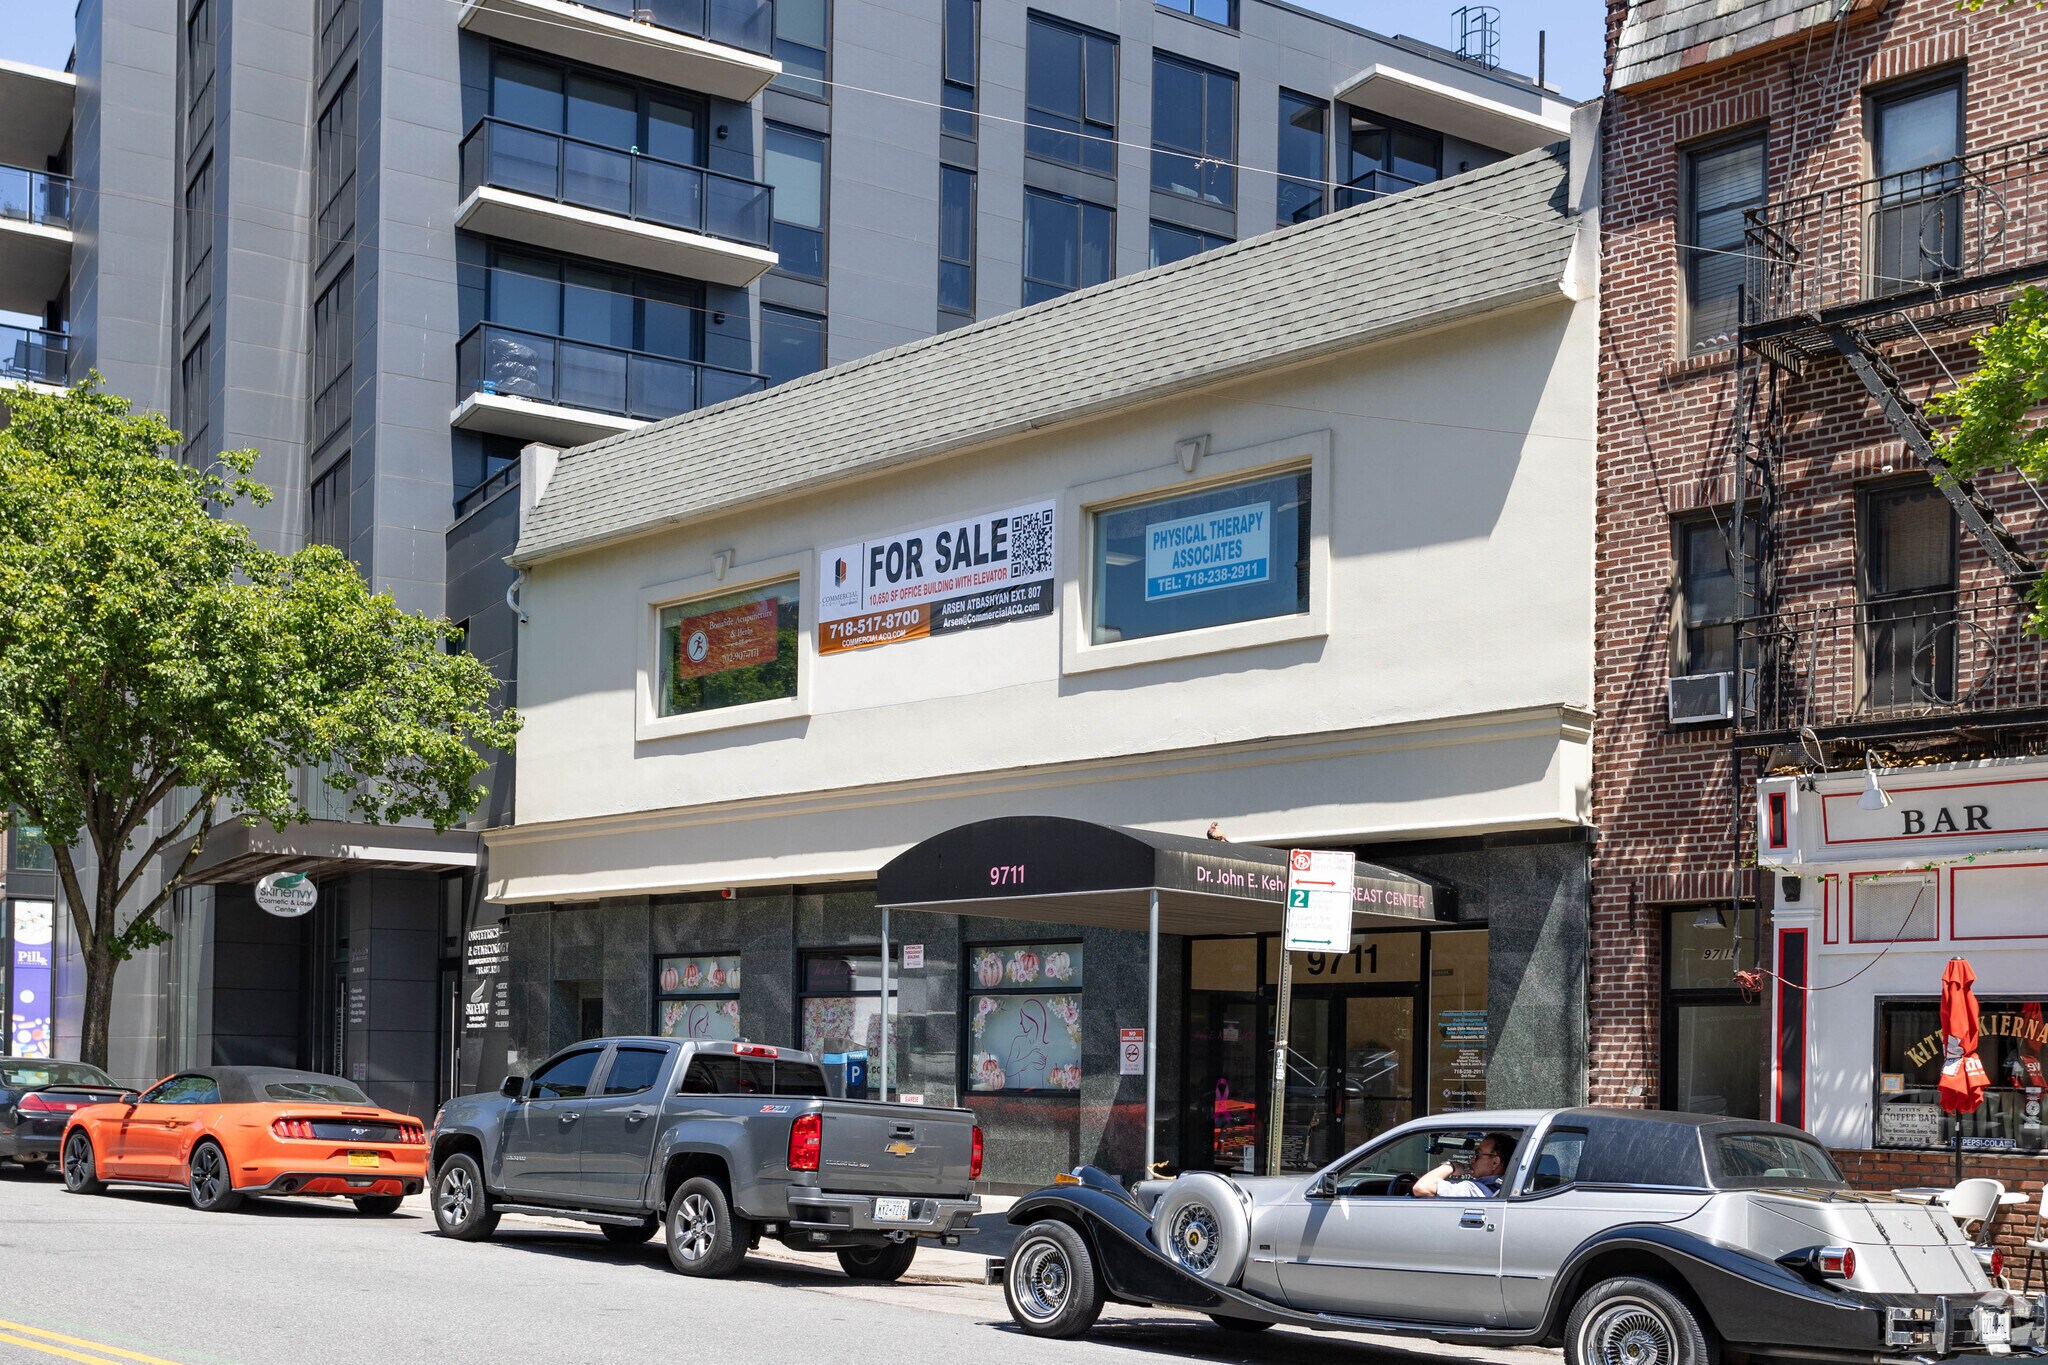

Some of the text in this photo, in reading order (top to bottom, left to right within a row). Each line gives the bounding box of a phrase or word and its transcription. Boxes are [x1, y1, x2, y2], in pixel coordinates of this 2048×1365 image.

[1153, 511, 1264, 550] PHYSICAL THERAPY
[869, 518, 1008, 587] FOR SALE
[1172, 539, 1242, 569] ASSOCIATES
[869, 592, 889, 607] 10,650
[890, 589, 899, 602] SF
[899, 585, 922, 600] OFFICE
[923, 580, 954, 596] BUILDING
[955, 576, 972, 589] WITH
[973, 568, 1008, 585] ELEVATOR
[1158, 562, 1258, 592] TEL: 718-238-2911
[942, 586, 1042, 616] ARSEN ATBASHYAN EXT. 807
[943, 602, 1040, 628] Arsen@CommercialACQ.com
[735, 611, 773, 625] Acupuncture
[829, 609, 920, 639] 718-517-8700
[1901, 804, 1992, 835] BAR
[990, 865, 1025, 885] 9711
[1197, 867, 1213, 883] Dr.
[1216, 869, 1244, 886] John
[1248, 873, 1258, 888] E.
[259, 897, 288, 906] Cosmetic
[1294, 890, 1305, 907] 2
[1352, 887, 1383, 903] REAST
[1385, 891, 1425, 909] CENTER
[1307, 944, 1377, 975] 9711
[1906, 1029, 1943, 1068] KITT
[851, 1065, 860, 1083] P
[1884, 1113, 1937, 1125] COFFEE BAR
[1962, 1138, 2005, 1148] PEPSI-COLA
